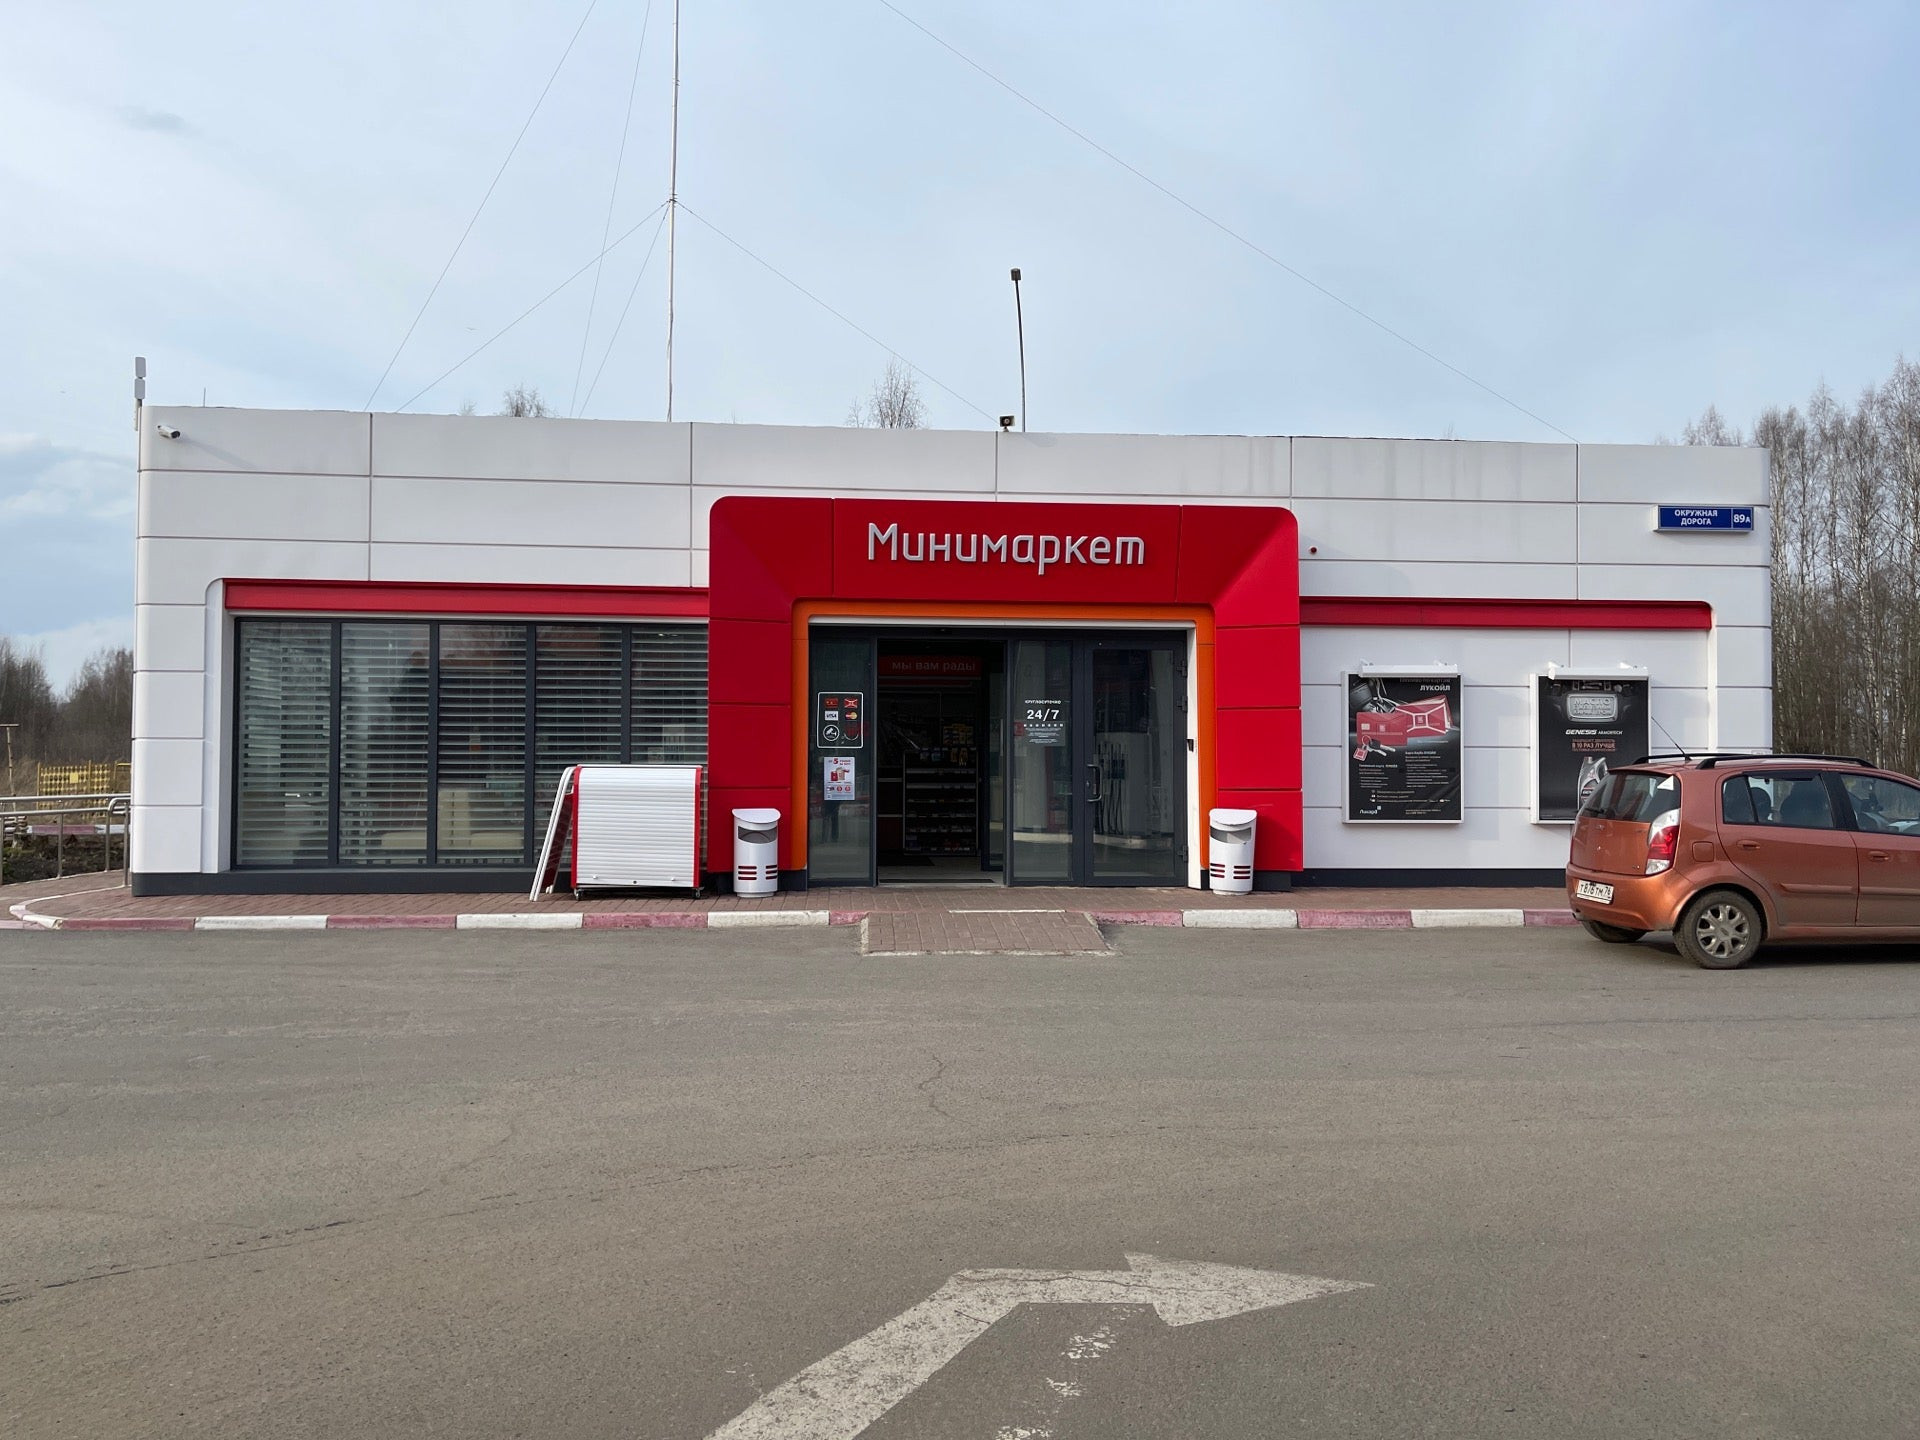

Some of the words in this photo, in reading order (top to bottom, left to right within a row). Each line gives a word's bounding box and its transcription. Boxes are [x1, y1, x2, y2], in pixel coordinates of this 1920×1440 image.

[1674, 509, 1718, 517] ОКРУЖНАЯ
[1680, 517, 1712, 526] ДОРОГА
[868, 522, 1145, 575] Минимаркет
[892, 662, 912, 671] мы
[915, 662, 939, 671] вам
[943, 662, 975, 673] рады
[1419, 683, 1451, 691] ЛУКОЙЛ
[1026, 708, 1060, 722] 24/7
